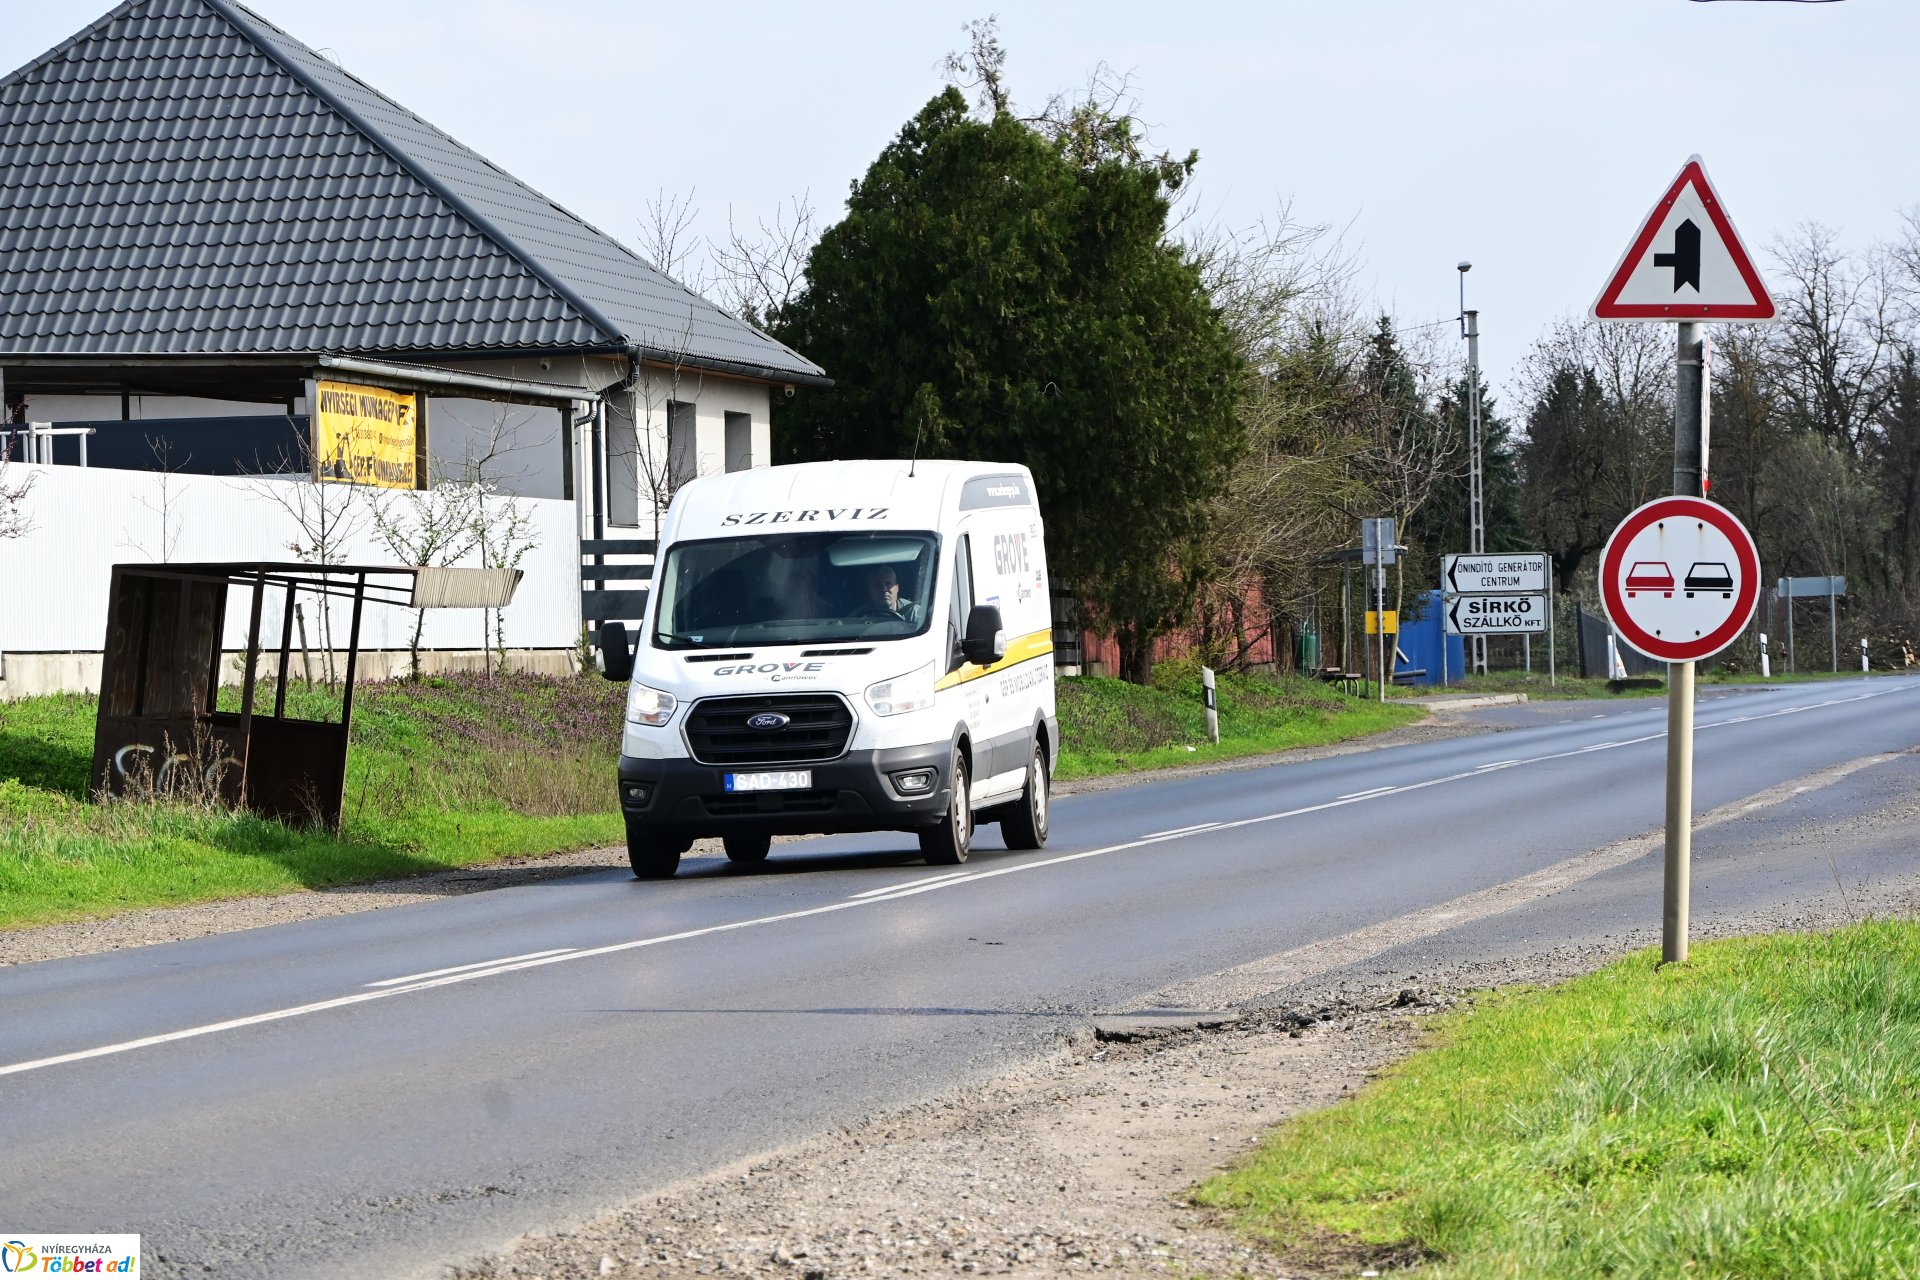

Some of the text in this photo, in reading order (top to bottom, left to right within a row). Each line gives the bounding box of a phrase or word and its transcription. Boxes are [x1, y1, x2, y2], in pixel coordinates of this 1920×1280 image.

[720, 507, 890, 527] SZERVIZ
[993, 533, 1030, 575] GROVE
[1498, 560, 1543, 573] GENERÁTOR
[1481, 576, 1521, 587] CENTRUM
[1524, 619, 1542, 627] KFT
[713, 662, 826, 676] GROVE
[755, 716, 777, 726] Ford
[736, 772, 808, 790] SAD-430
